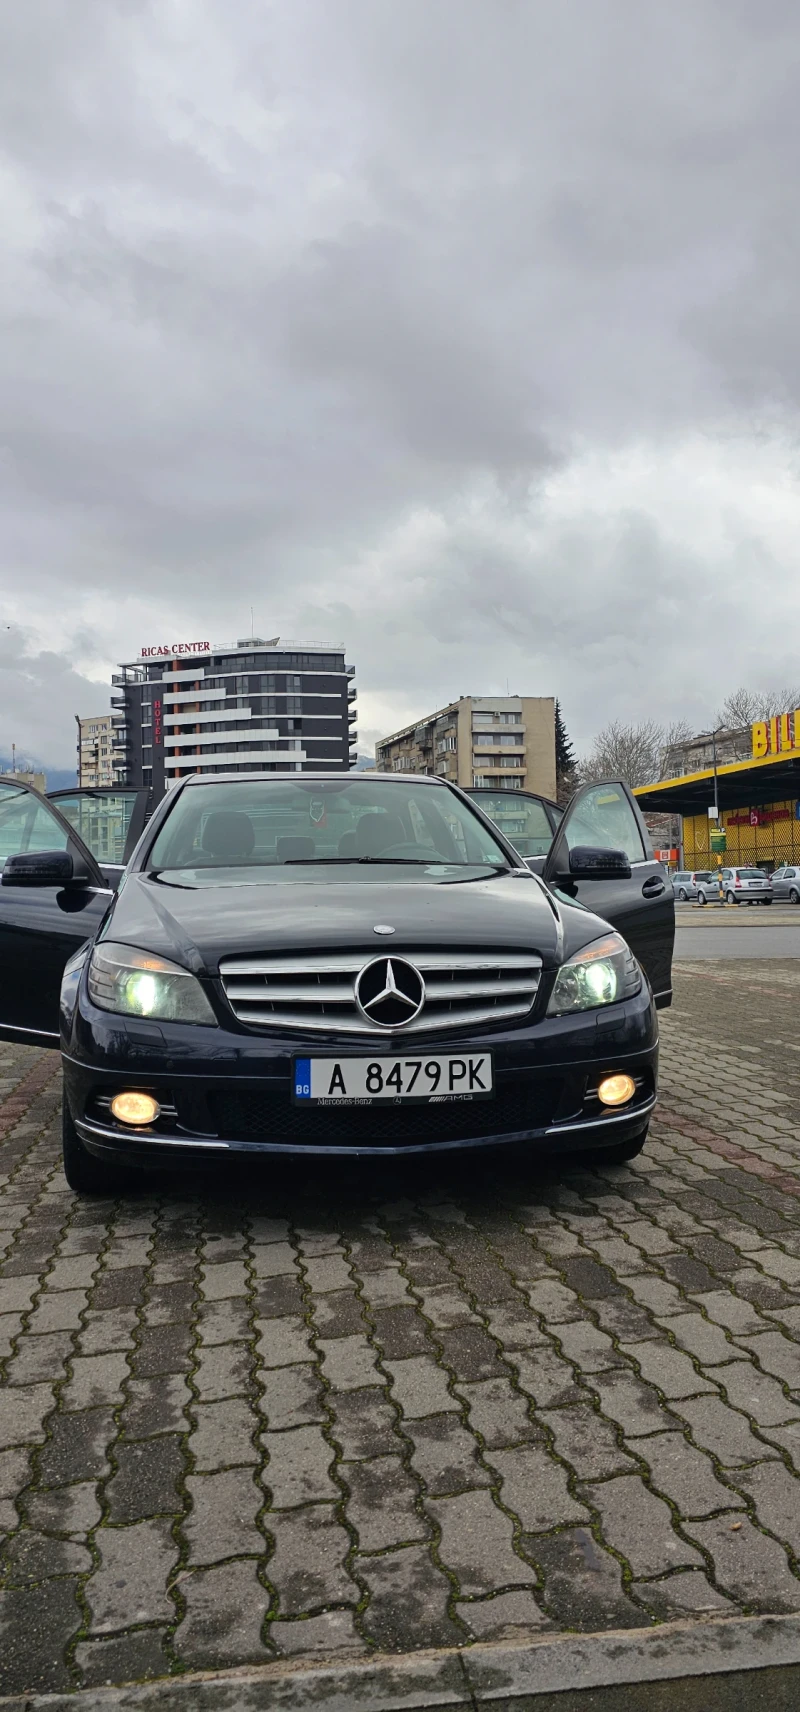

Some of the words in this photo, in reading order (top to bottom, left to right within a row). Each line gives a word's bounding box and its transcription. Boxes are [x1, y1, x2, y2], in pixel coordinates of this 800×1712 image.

[141, 645, 169, 657] RICAS
[171, 641, 210, 654] CENTER
[328, 1063, 347, 1095] A
[295, 1084, 310, 1095] BG
[317, 1096, 373, 1106] Mercedes-Benz
[442, 1094, 474, 1102] AMG
